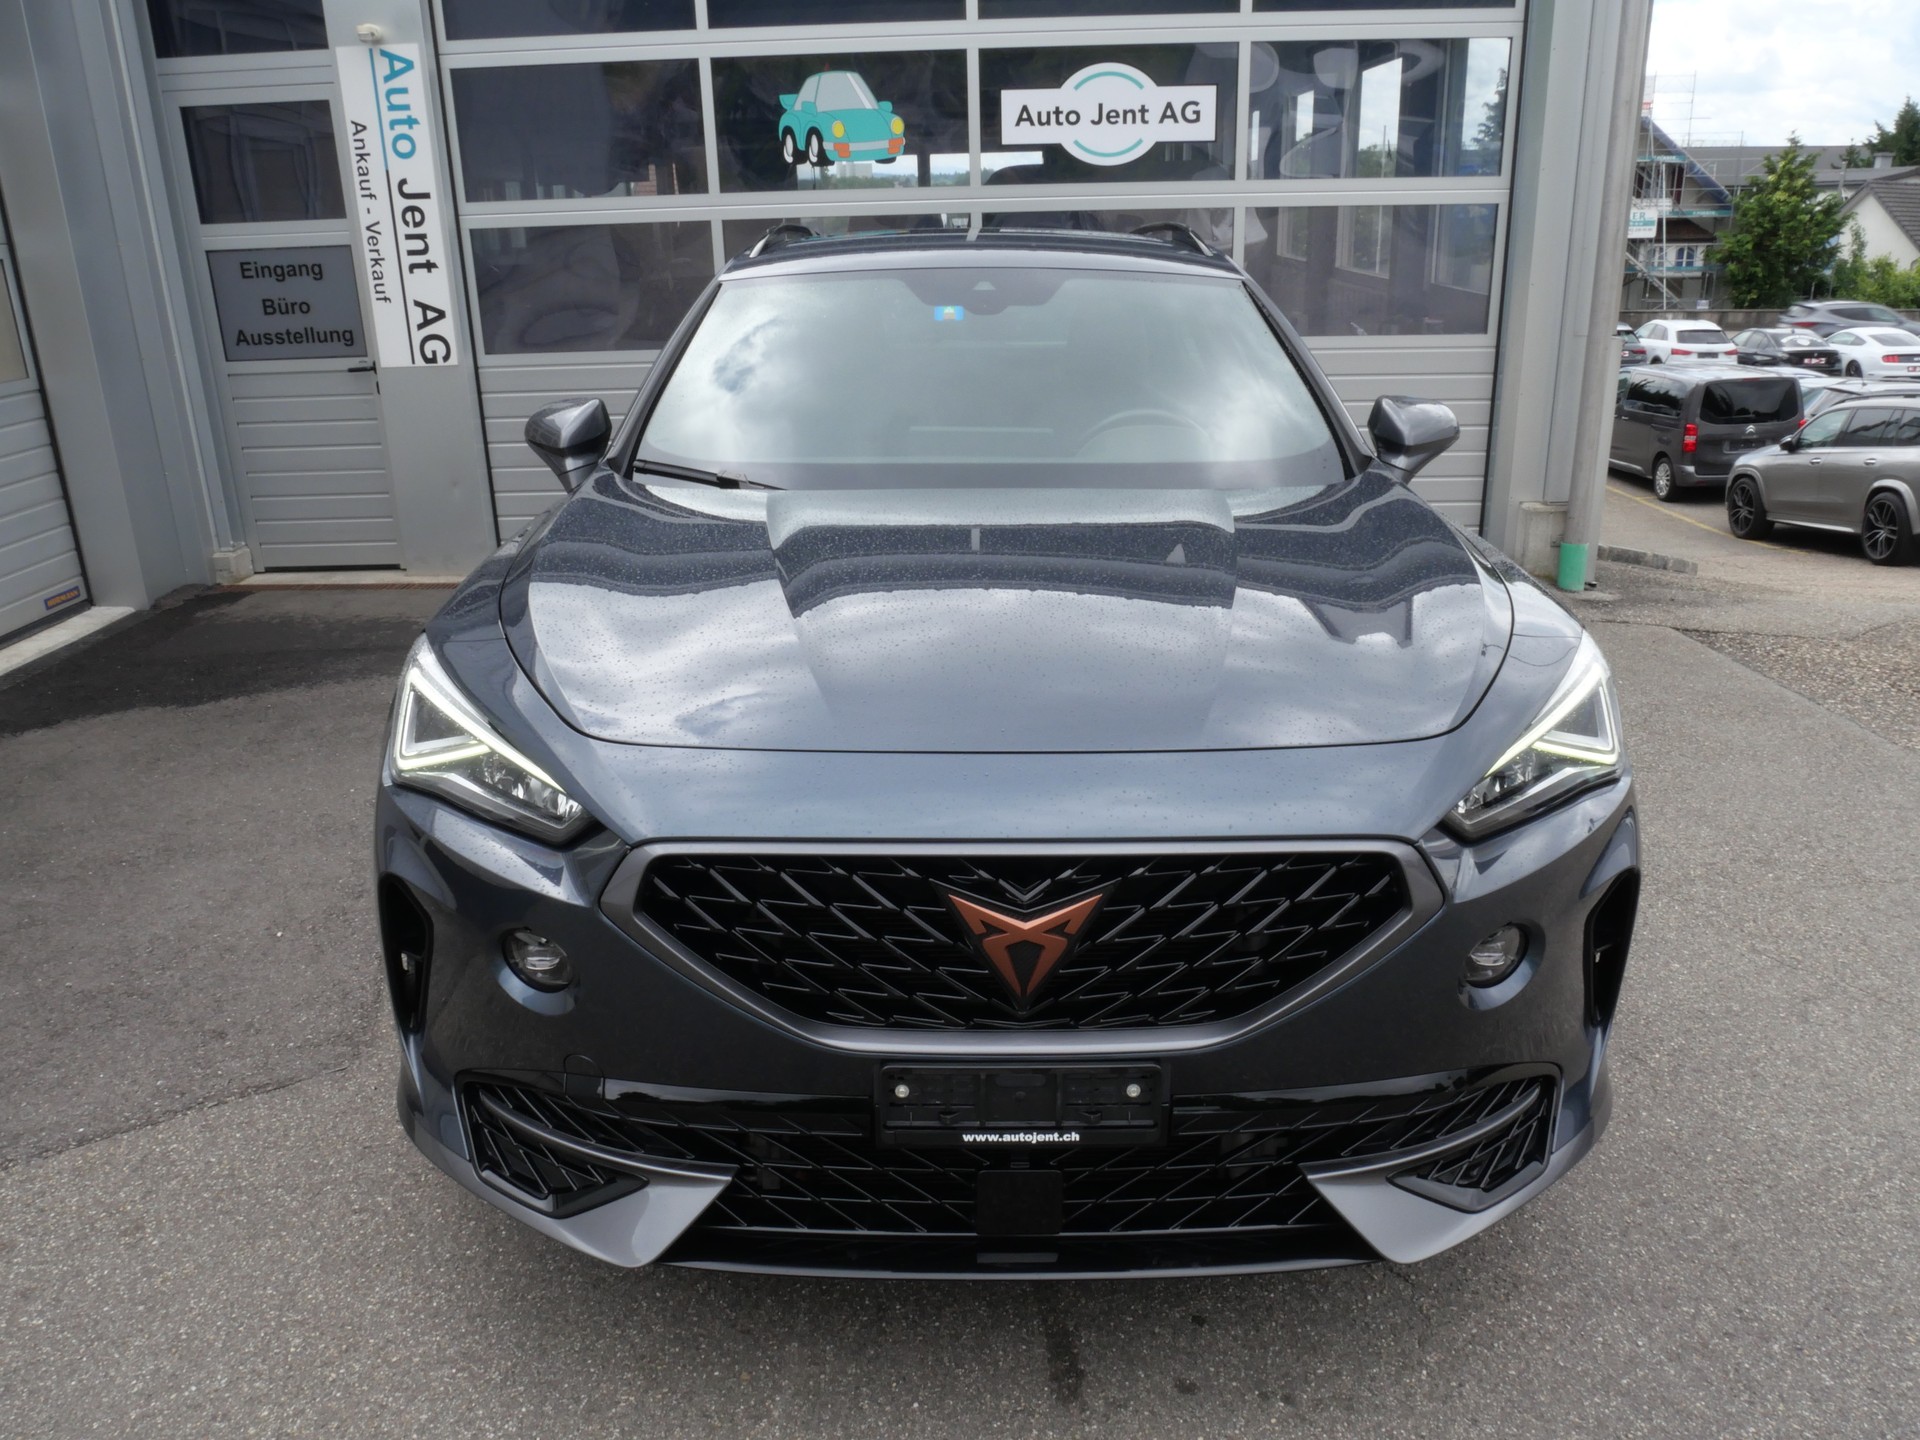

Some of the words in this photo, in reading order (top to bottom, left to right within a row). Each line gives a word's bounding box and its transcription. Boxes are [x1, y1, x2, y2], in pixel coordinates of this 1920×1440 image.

[379, 48, 421, 160] Auto
[1015, 104, 1081, 127] Auto
[1090, 103, 1150, 126] Jent
[1158, 101, 1201, 125] AG
[350, 119, 377, 201] Ankauf
[365, 220, 392, 304] Verkauf
[397, 177, 439, 274] Jent
[239, 261, 324, 283] Eingang
[261, 297, 311, 317] Büro
[235, 326, 355, 348] Ausstellung
[413, 299, 451, 365] AG
[962, 1131, 1081, 1145] www.autojent.ch
